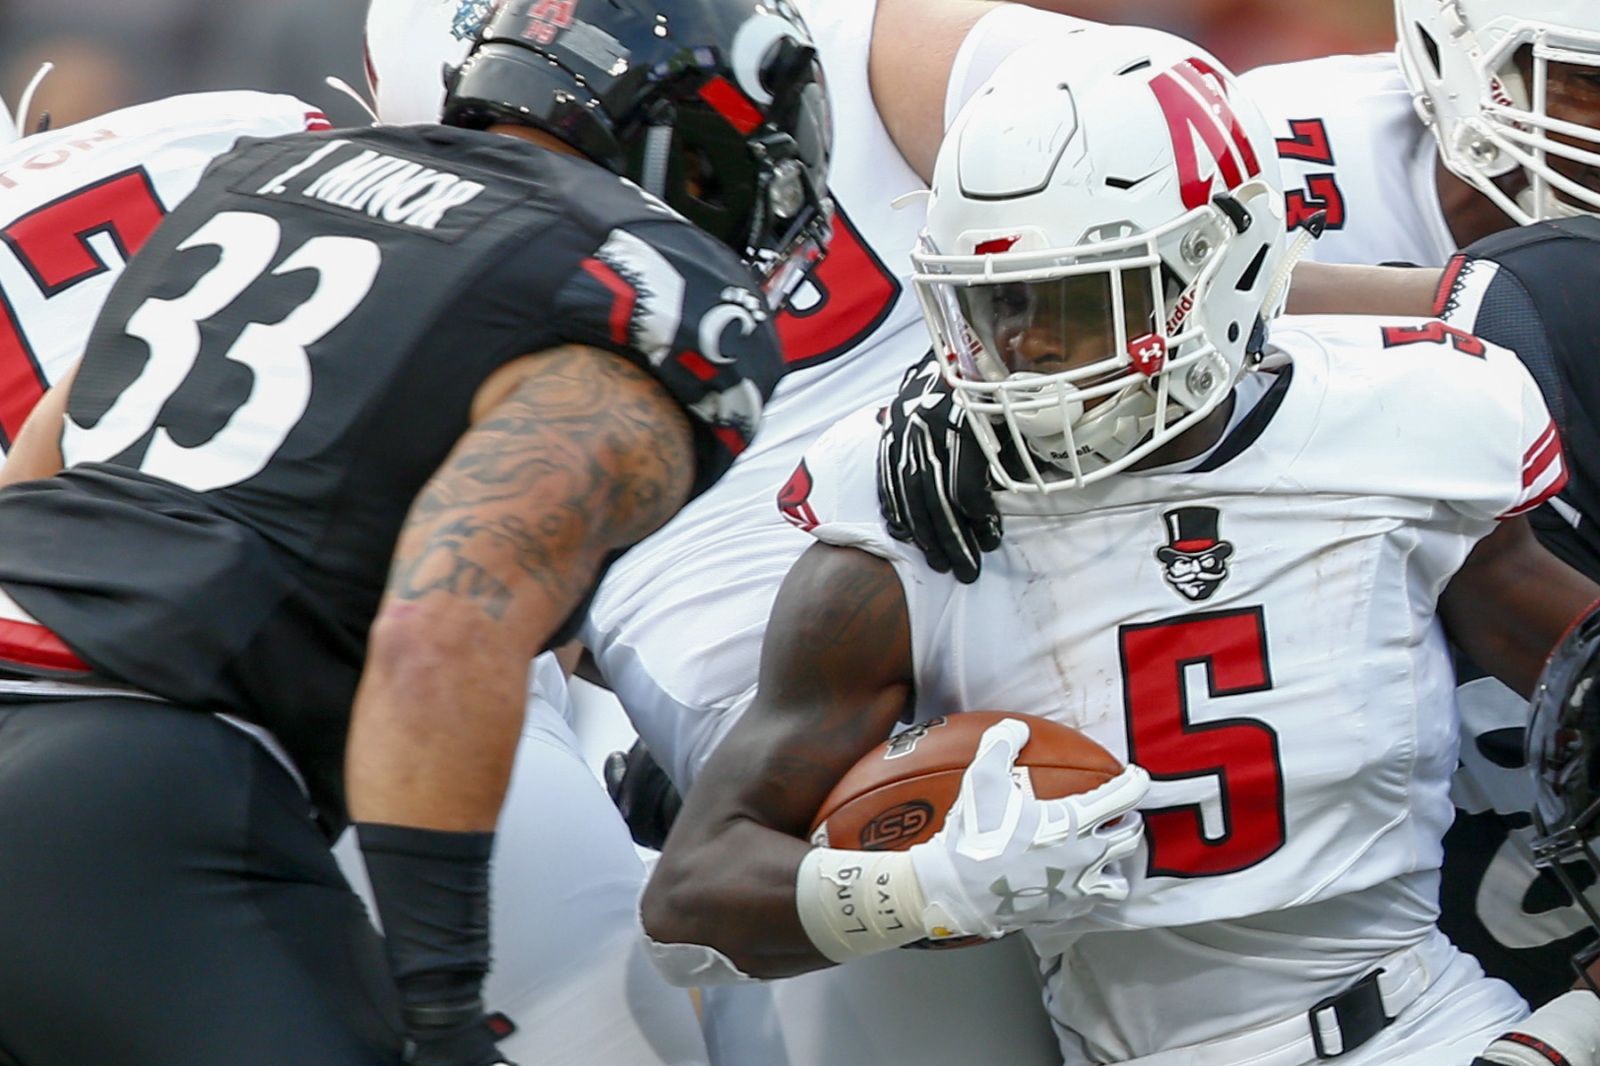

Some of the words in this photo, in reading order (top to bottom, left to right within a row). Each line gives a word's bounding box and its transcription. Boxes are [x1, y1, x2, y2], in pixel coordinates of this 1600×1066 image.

[302, 149, 486, 229] MINOR
[1274, 117, 1346, 232] 73
[60, 211, 382, 493] 33
[1118, 603, 1287, 880] 5
[836, 865, 868, 935] Long
[875, 872, 904, 932] Live
